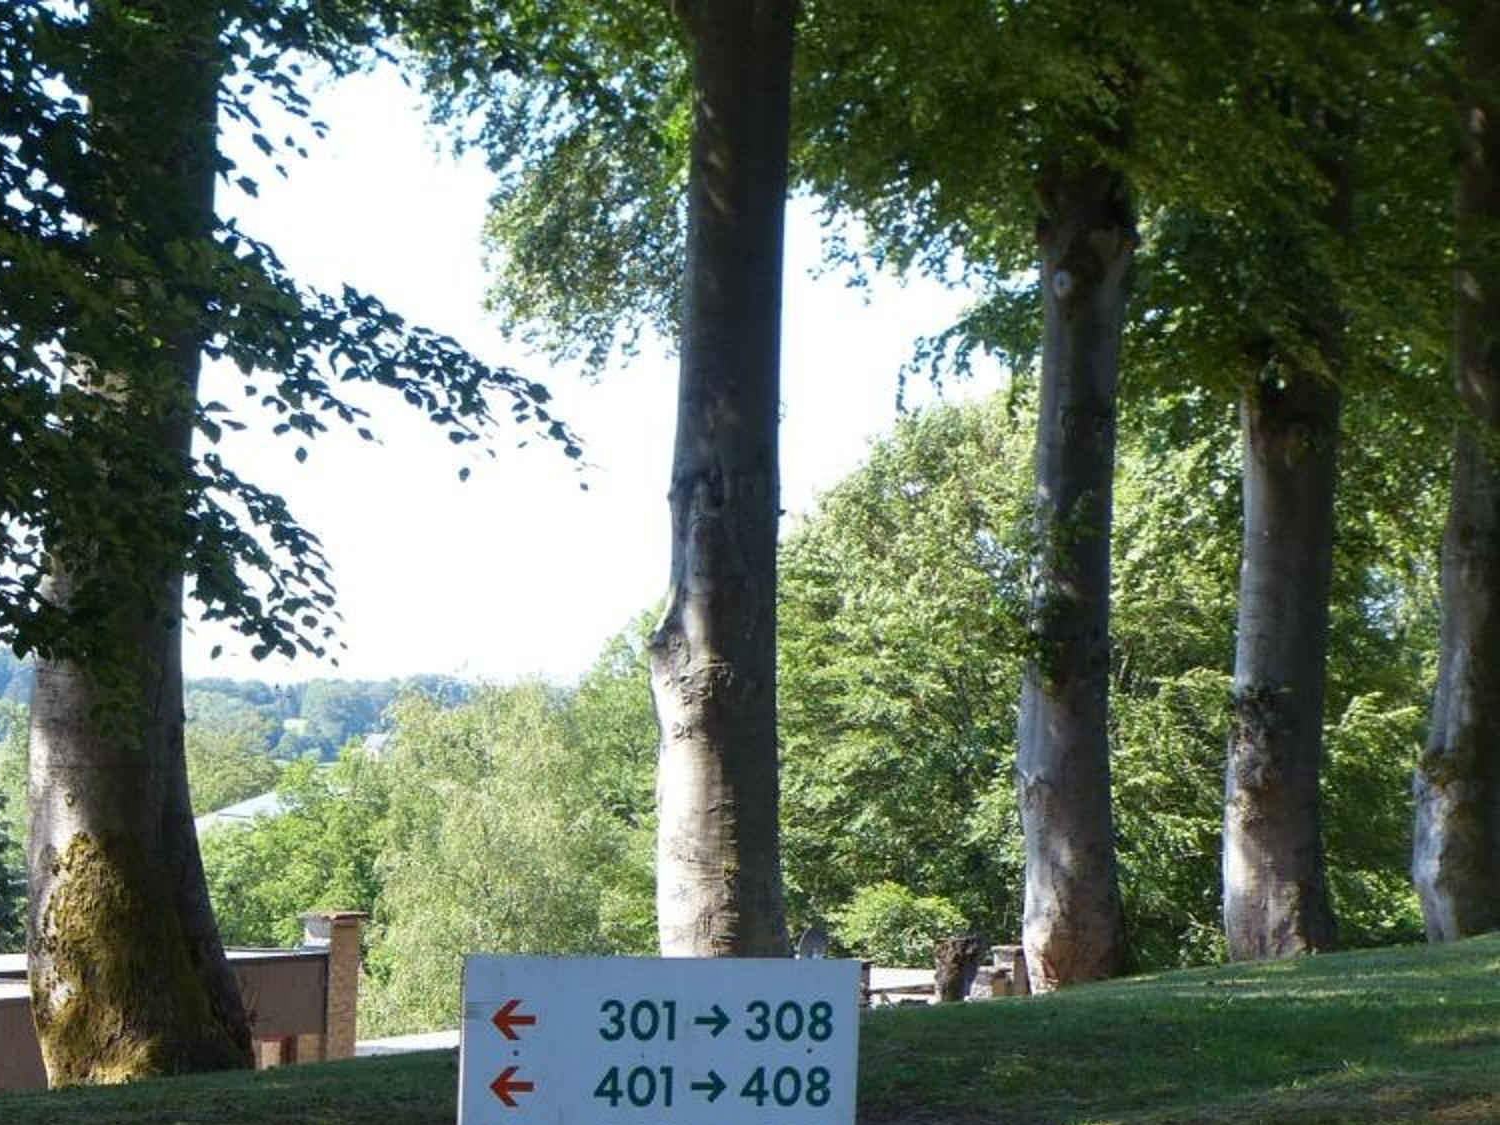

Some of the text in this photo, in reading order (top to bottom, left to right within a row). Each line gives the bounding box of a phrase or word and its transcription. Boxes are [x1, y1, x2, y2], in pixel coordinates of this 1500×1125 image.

[599, 999, 834, 1042] 301 308
[593, 1065, 831, 1108] 401 408
